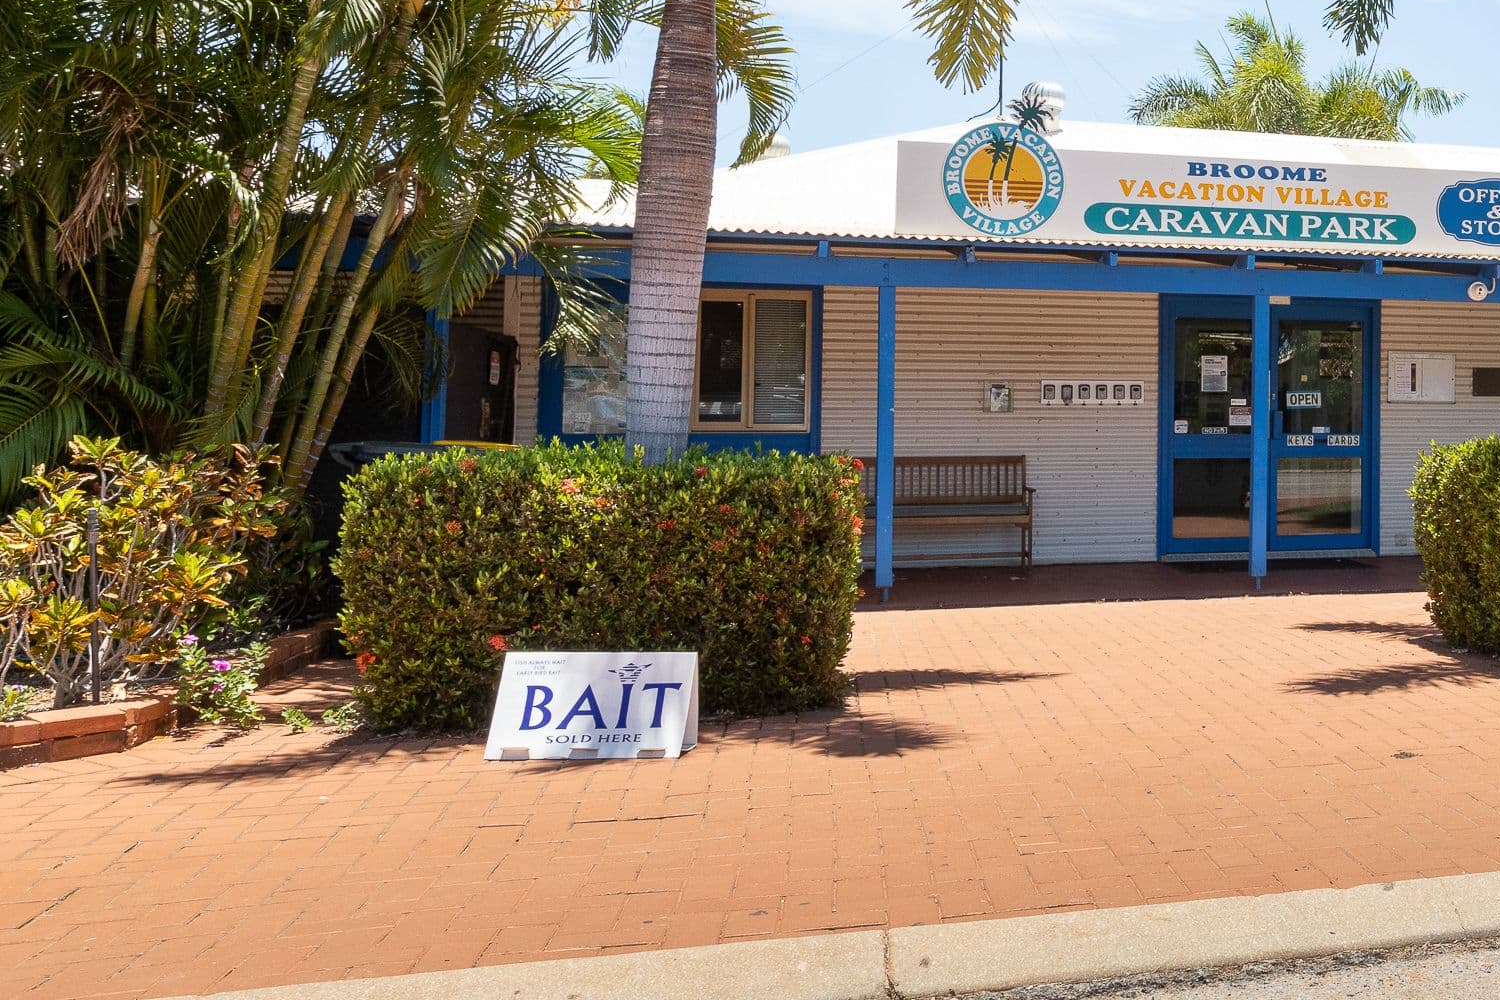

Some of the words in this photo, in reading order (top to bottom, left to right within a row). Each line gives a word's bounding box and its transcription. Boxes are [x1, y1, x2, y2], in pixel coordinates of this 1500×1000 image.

[946, 128, 993, 195] BROOME
[998, 126, 1061, 200] VACATION
[1187, 161, 1327, 183] BROOME
[1118, 179, 1265, 203] VACATION
[1275, 186, 1389, 209] VILLAGE
[962, 205, 1045, 235] VILLAGE
[1104, 207, 1290, 238] CARAVAN
[1300, 215, 1398, 241] PARK
[1290, 394, 1318, 405] OPEN
[1288, 436, 1313, 445] KEYS
[1328, 436, 1359, 445] CARDS
[519, 682, 682, 731] BAIT
[546, 734, 592, 744] SOLD
[598, 733, 642, 743] HERE
